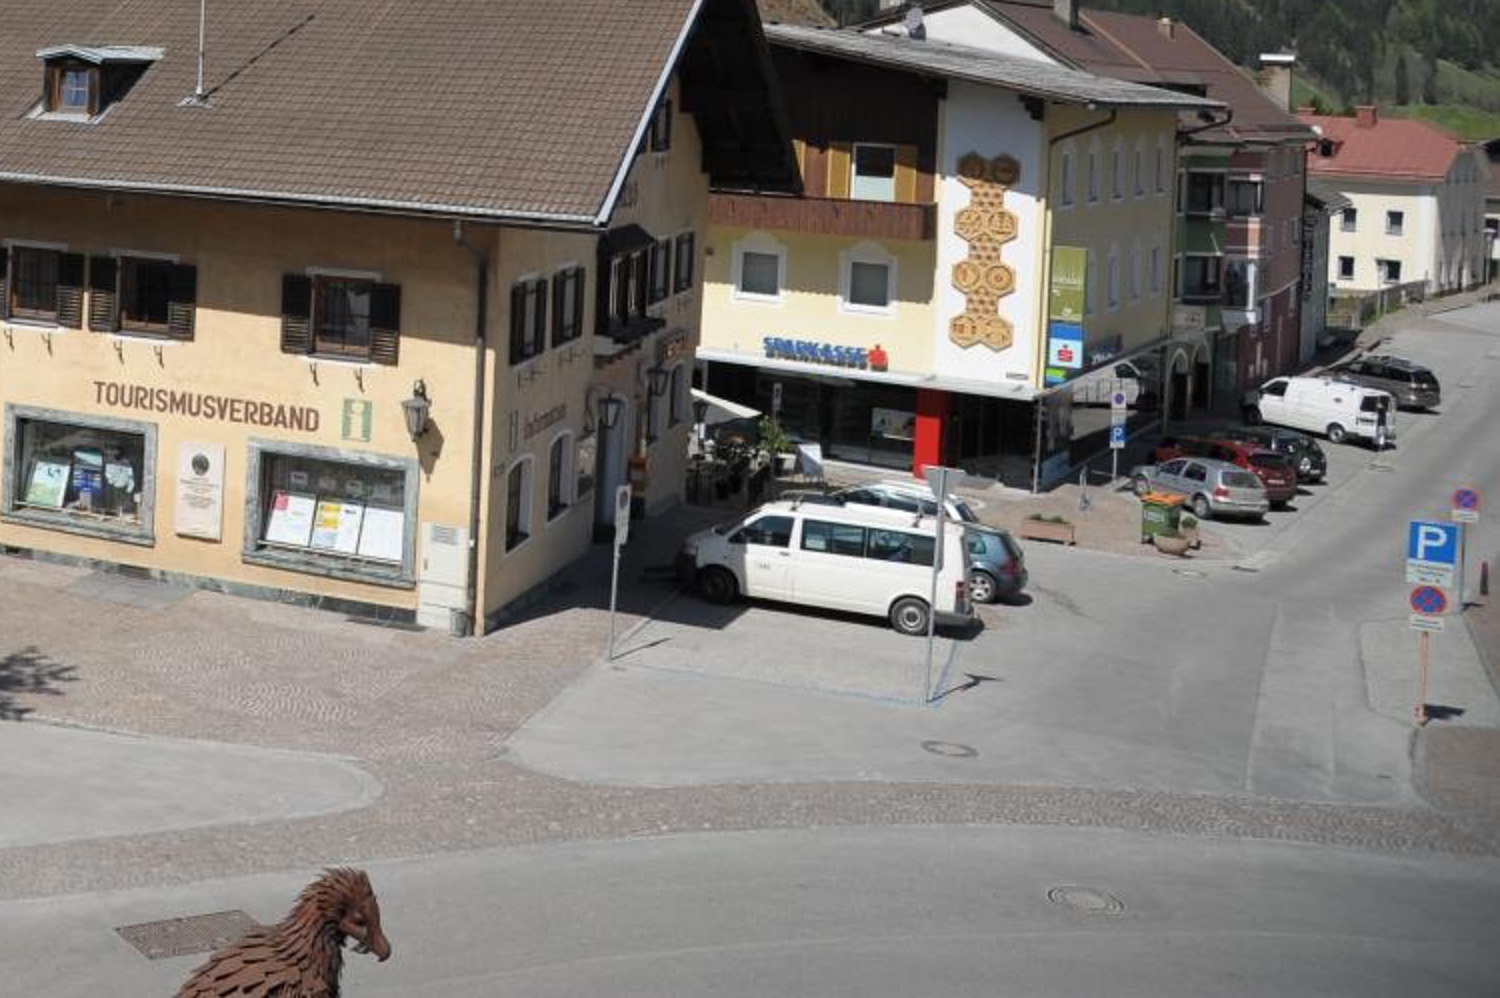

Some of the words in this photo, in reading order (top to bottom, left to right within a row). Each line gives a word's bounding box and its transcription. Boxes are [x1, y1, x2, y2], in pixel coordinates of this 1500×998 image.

[93, 381, 320, 432] TOURISMUSVERBAND
[1113, 427, 1123, 442] P
[1416, 524, 1447, 559] P
